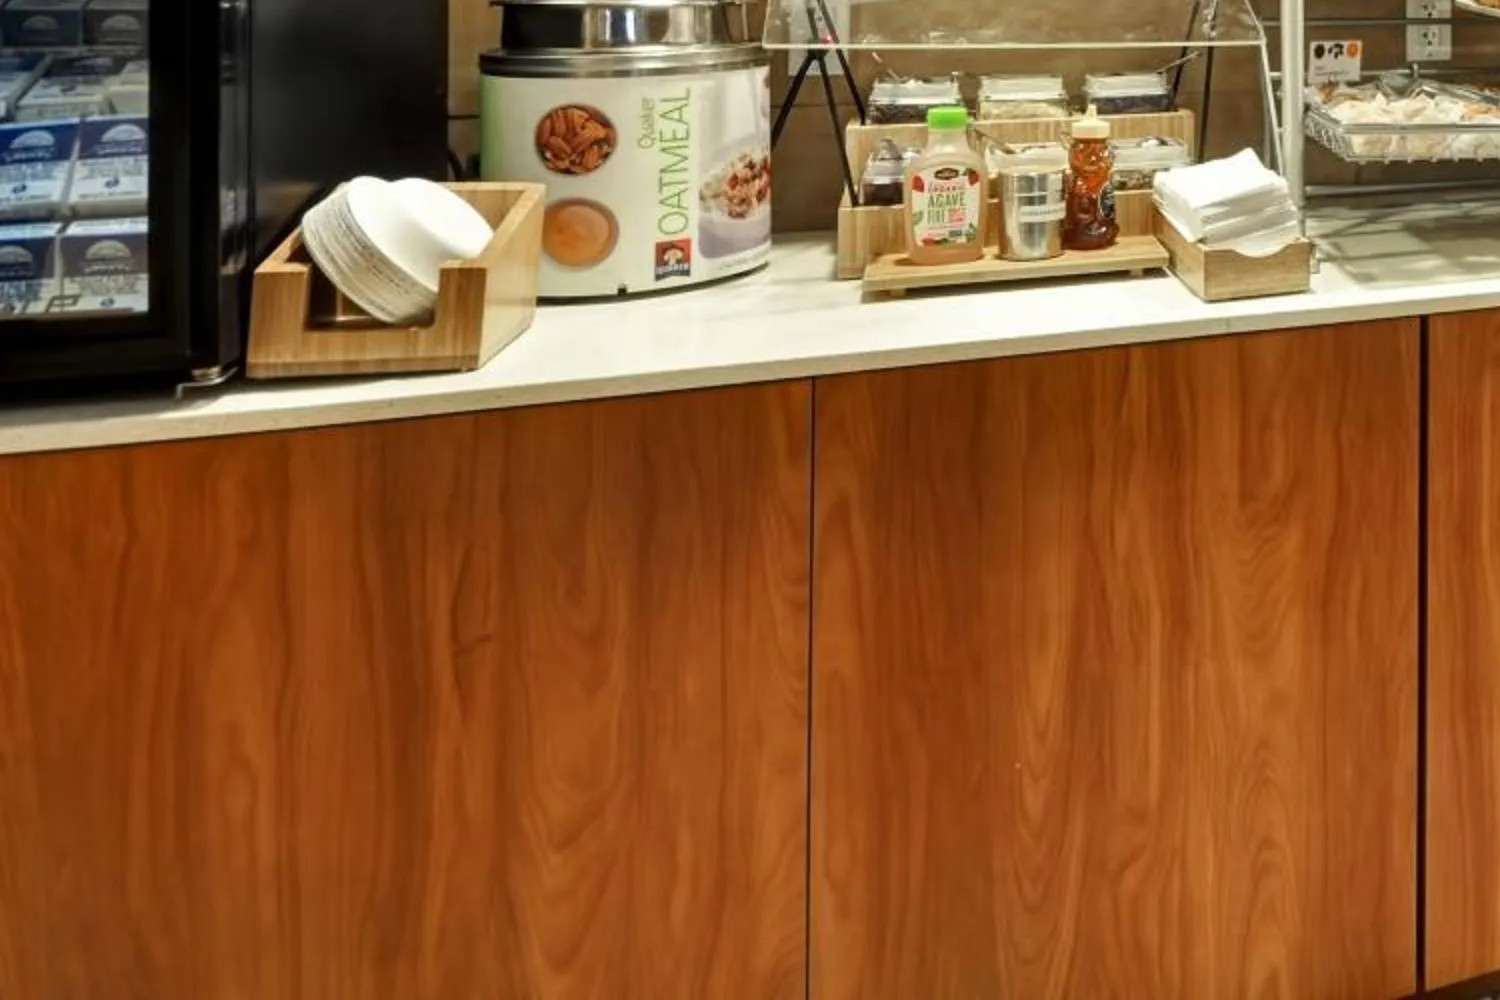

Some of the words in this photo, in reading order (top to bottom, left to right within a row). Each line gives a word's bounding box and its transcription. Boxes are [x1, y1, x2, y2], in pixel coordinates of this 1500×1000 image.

[637, 97, 657, 149] Quaker
[657, 87, 691, 236] OATMEAL
[927, 192, 967, 208] AGAVE
